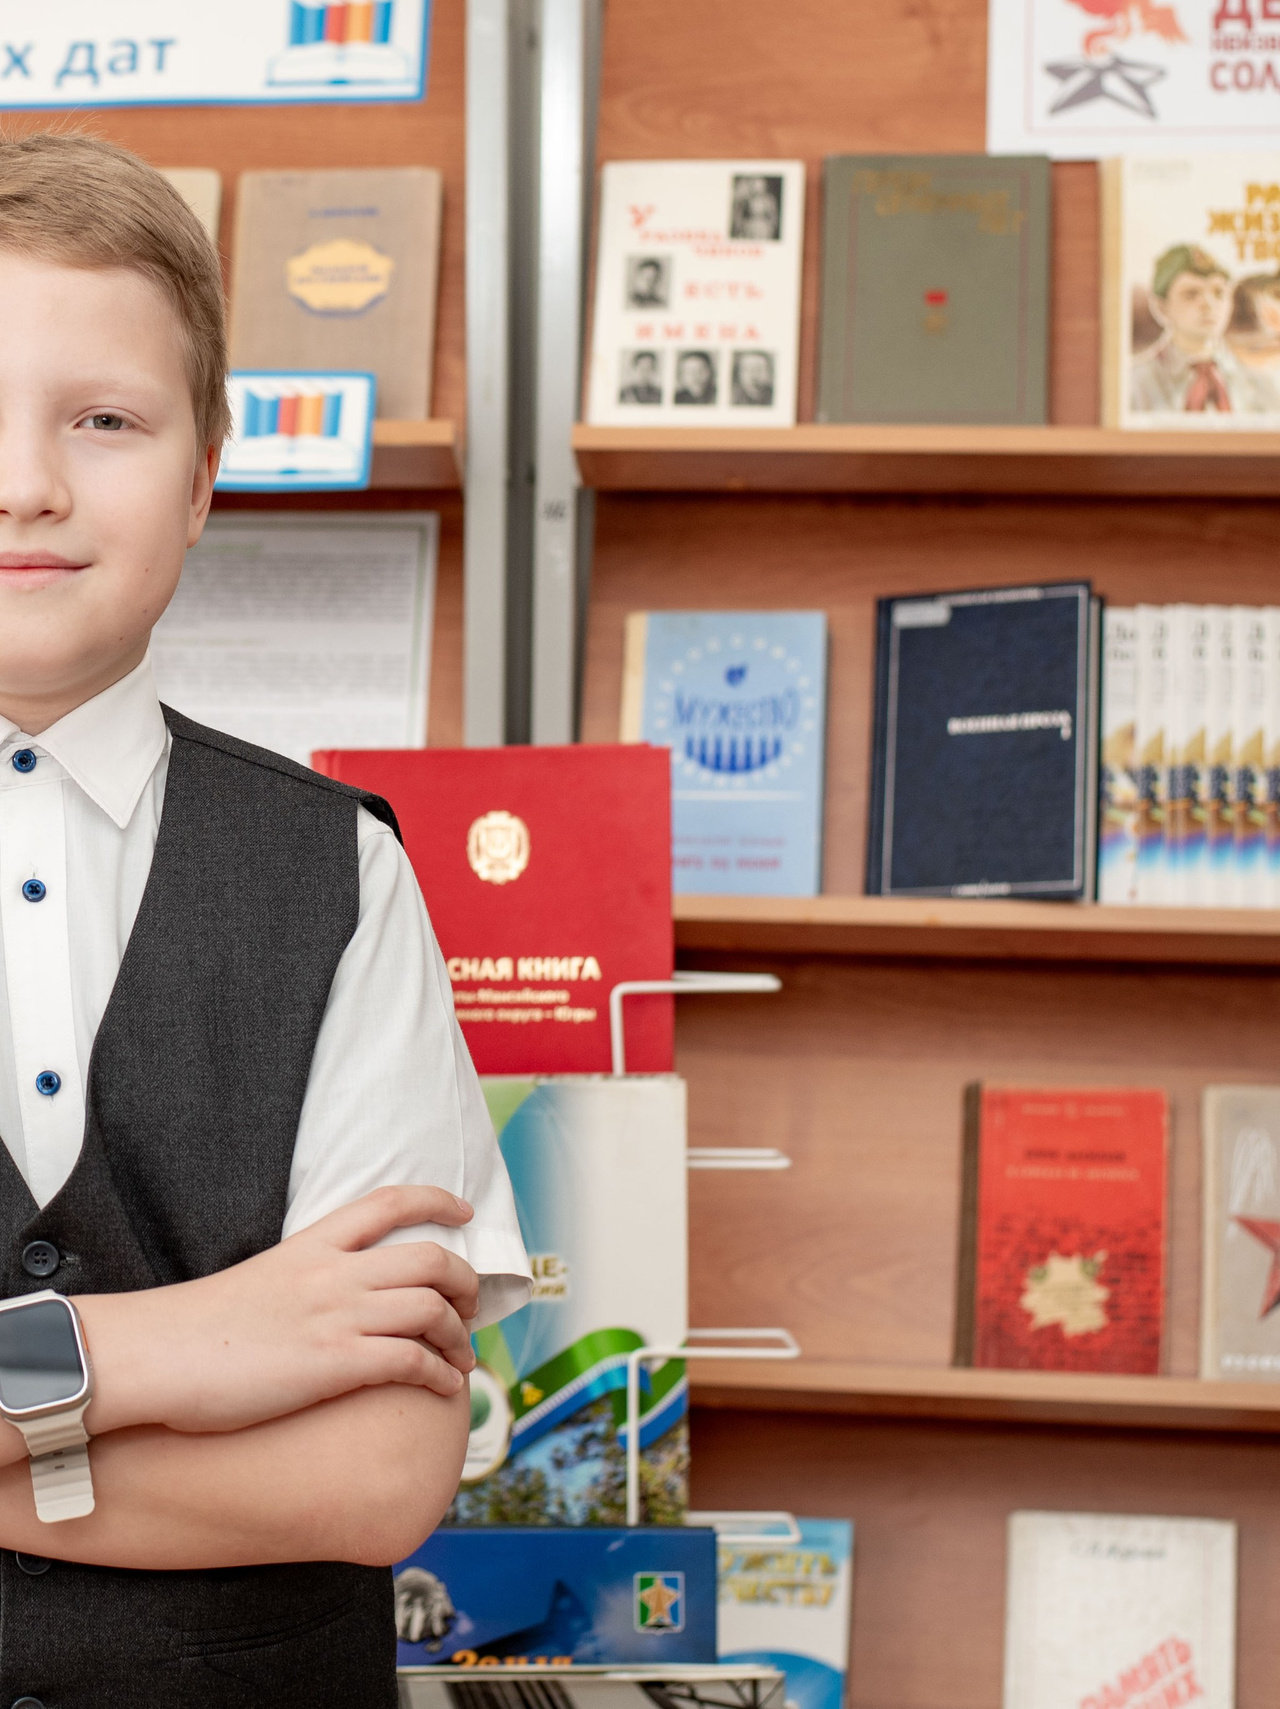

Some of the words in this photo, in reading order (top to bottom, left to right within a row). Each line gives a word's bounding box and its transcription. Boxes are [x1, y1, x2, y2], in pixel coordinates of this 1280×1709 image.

[55, 36, 177, 89] дат
[634, 323, 761, 341] ИМЕНА
[517, 955, 603, 982] КНИГА
